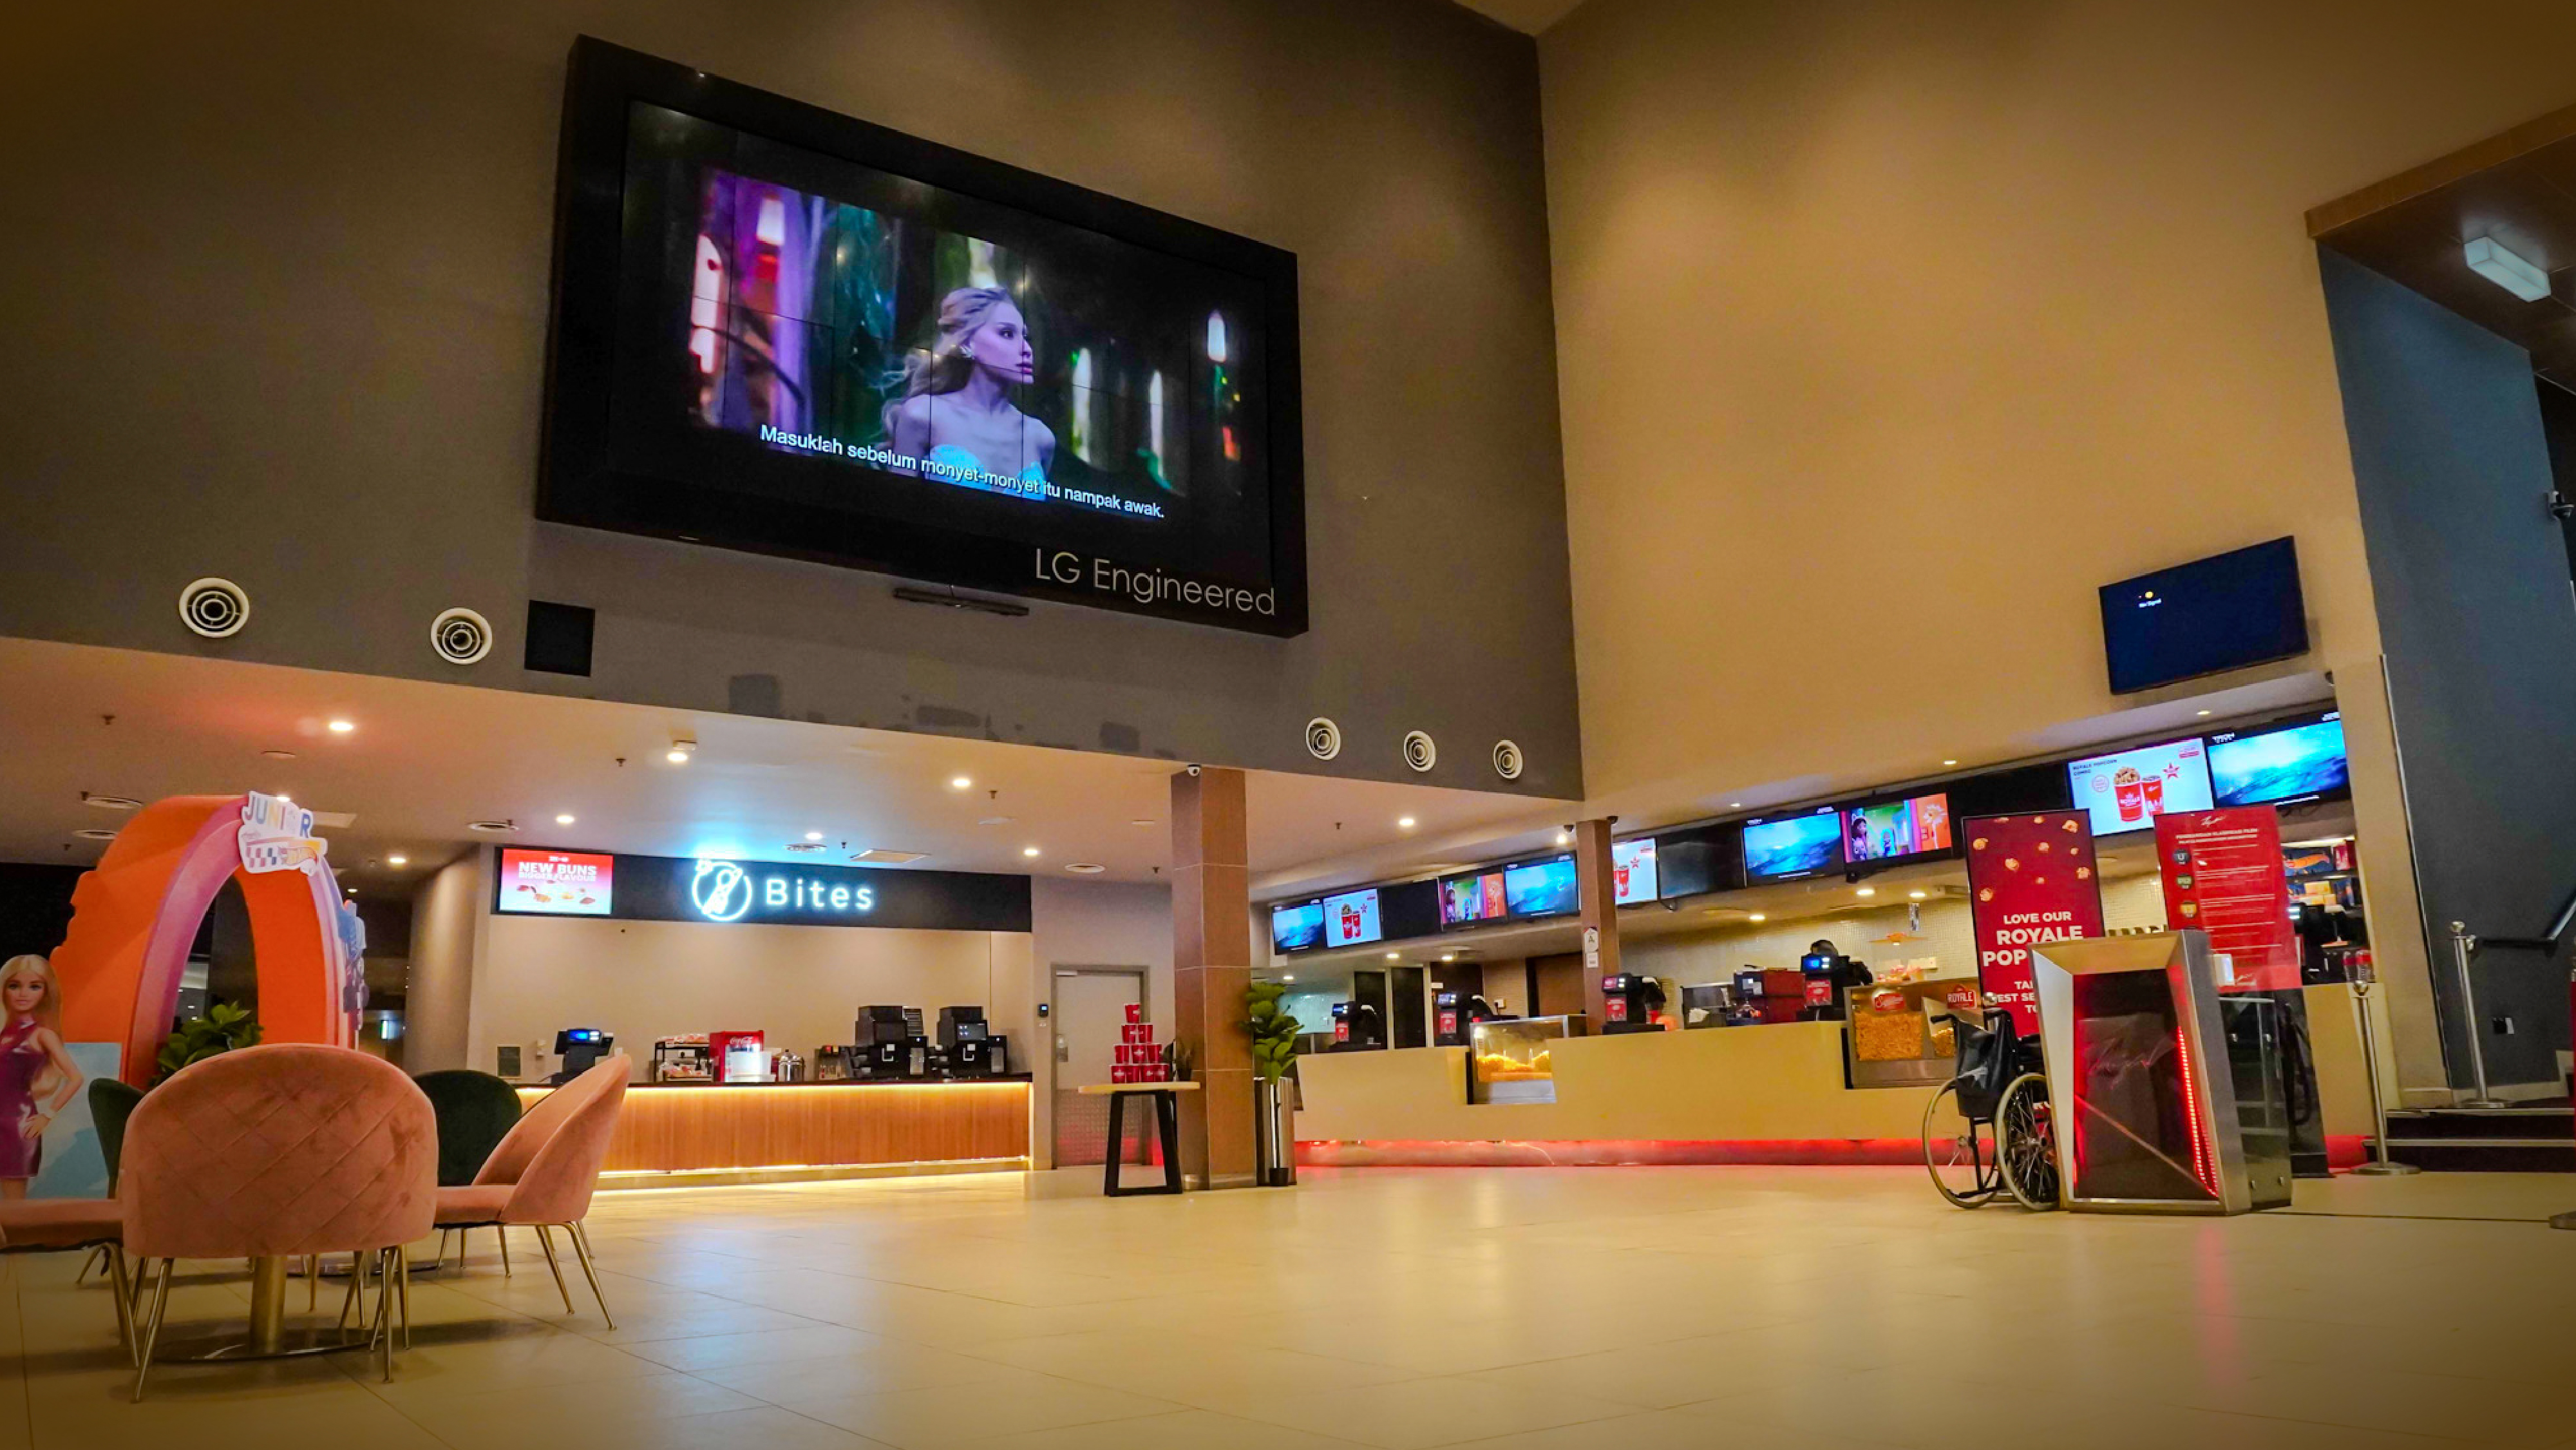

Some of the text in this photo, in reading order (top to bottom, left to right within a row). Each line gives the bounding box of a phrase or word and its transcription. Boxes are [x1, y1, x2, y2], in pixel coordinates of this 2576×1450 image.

[760, 423, 1164, 518] Masuklah sebelum monyet-monyet itu nampak awak.
[1036, 548, 1275, 616] LG Engineered
[518, 862, 597, 877] NEW BUNS
[766, 878, 873, 910] Bites
[2003, 911, 2072, 925] LOVE OUR
[1996, 925, 2083, 945] ROYALE
[1982, 949, 2027, 967] POP
[1996, 992, 2035, 1003] EST SE
